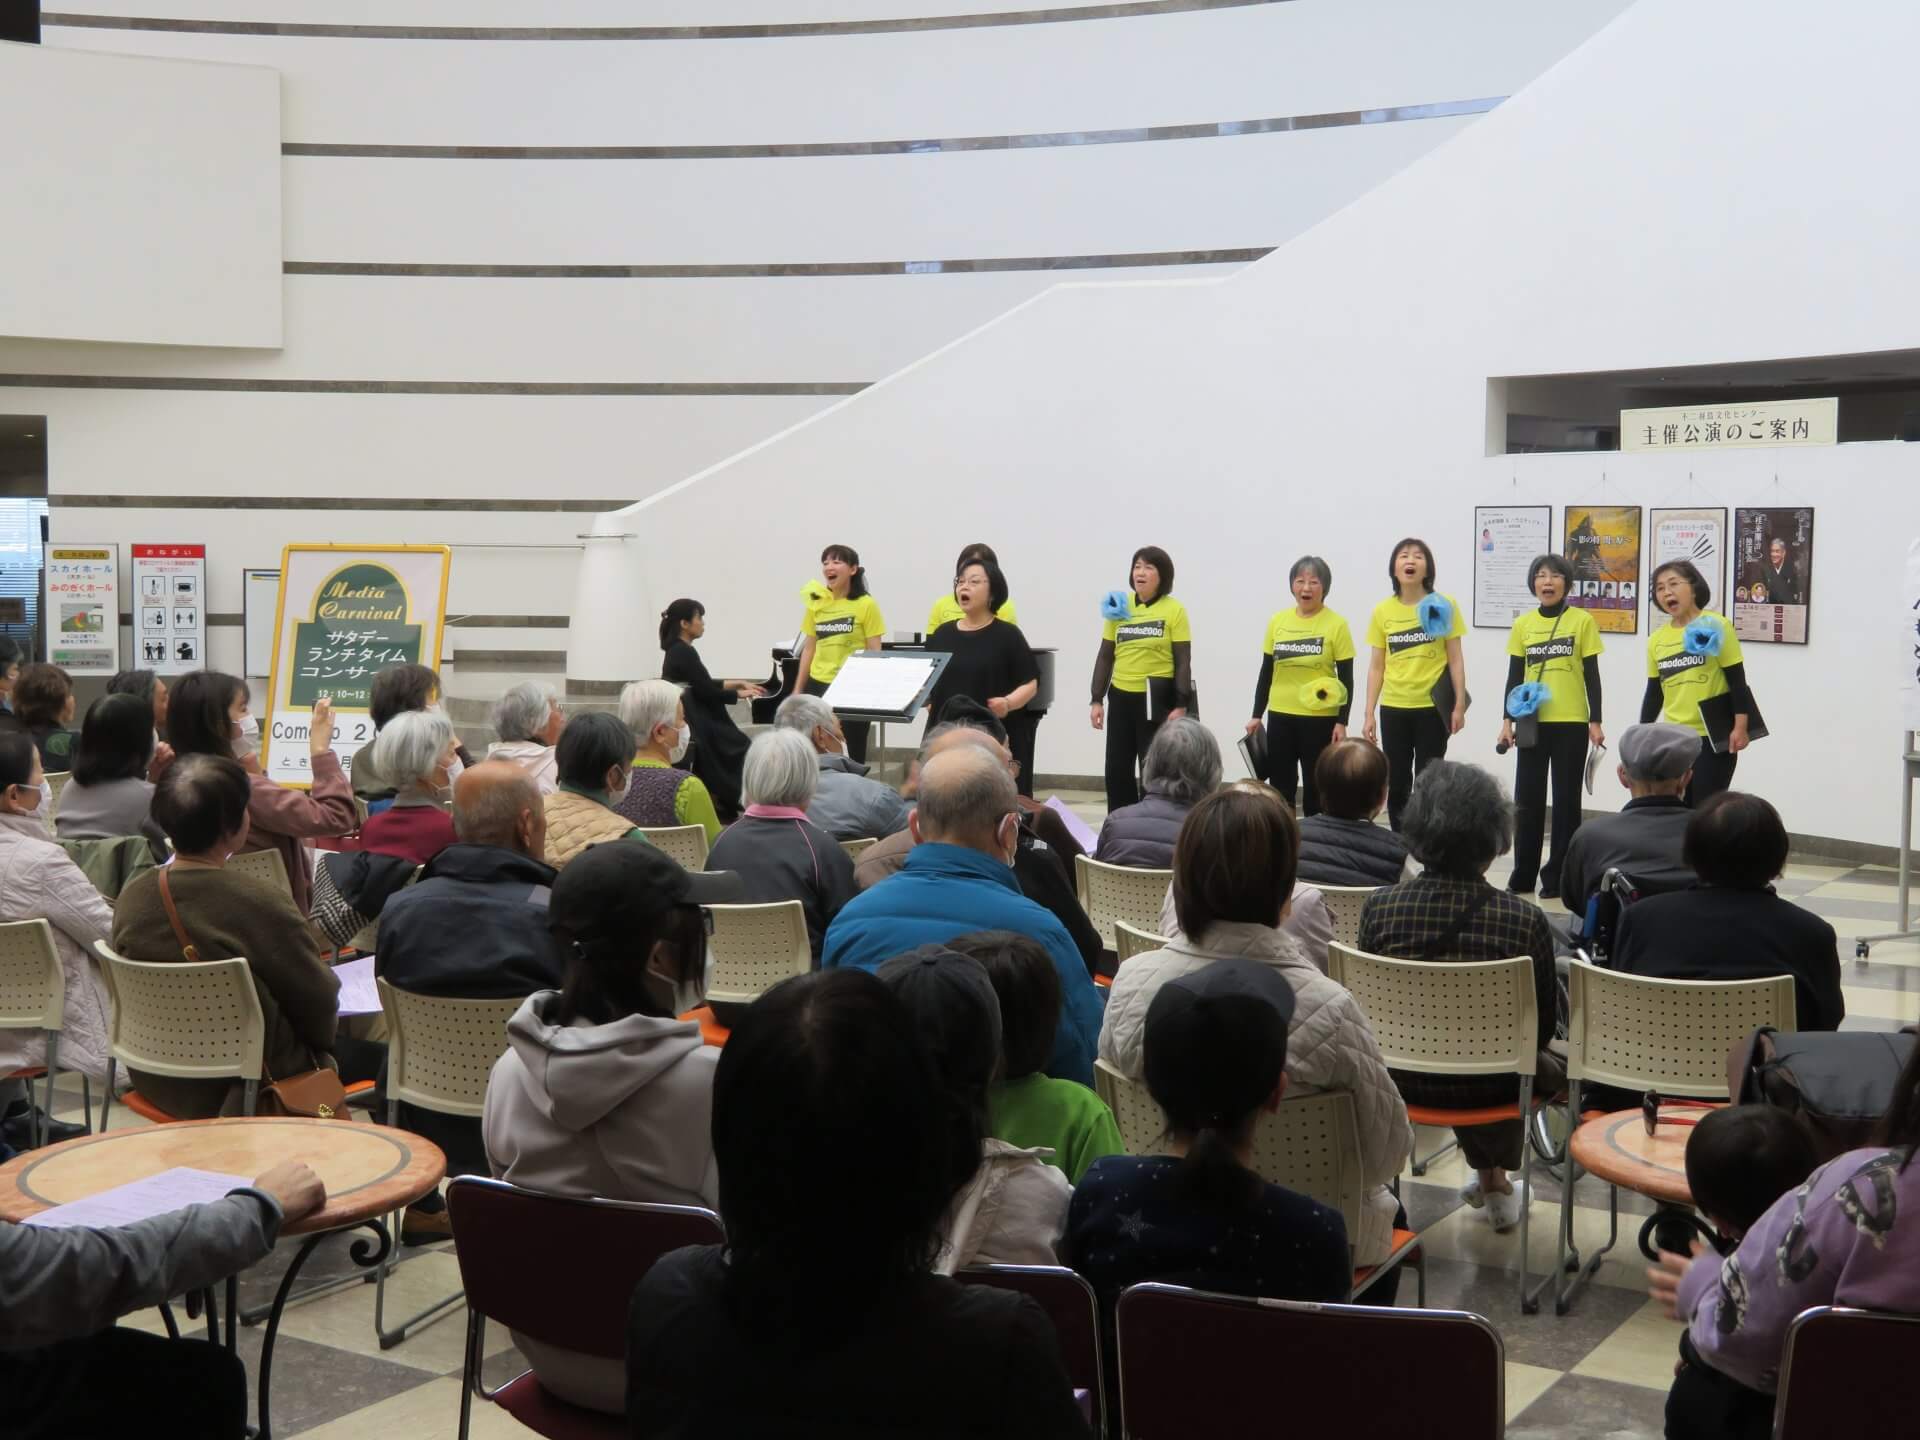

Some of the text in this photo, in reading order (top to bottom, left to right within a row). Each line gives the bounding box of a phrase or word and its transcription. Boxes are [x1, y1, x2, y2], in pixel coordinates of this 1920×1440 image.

[1642, 417, 1809, 445] 主催公演のご案内
[50, 565, 113, 574] スカイホール
[323, 581, 386, 599] Media
[319, 601, 403, 620] Carnival
[326, 630, 390, 645] サタデー
[307, 647, 408, 663] ランチタイム
[272, 721, 341, 741] Como
